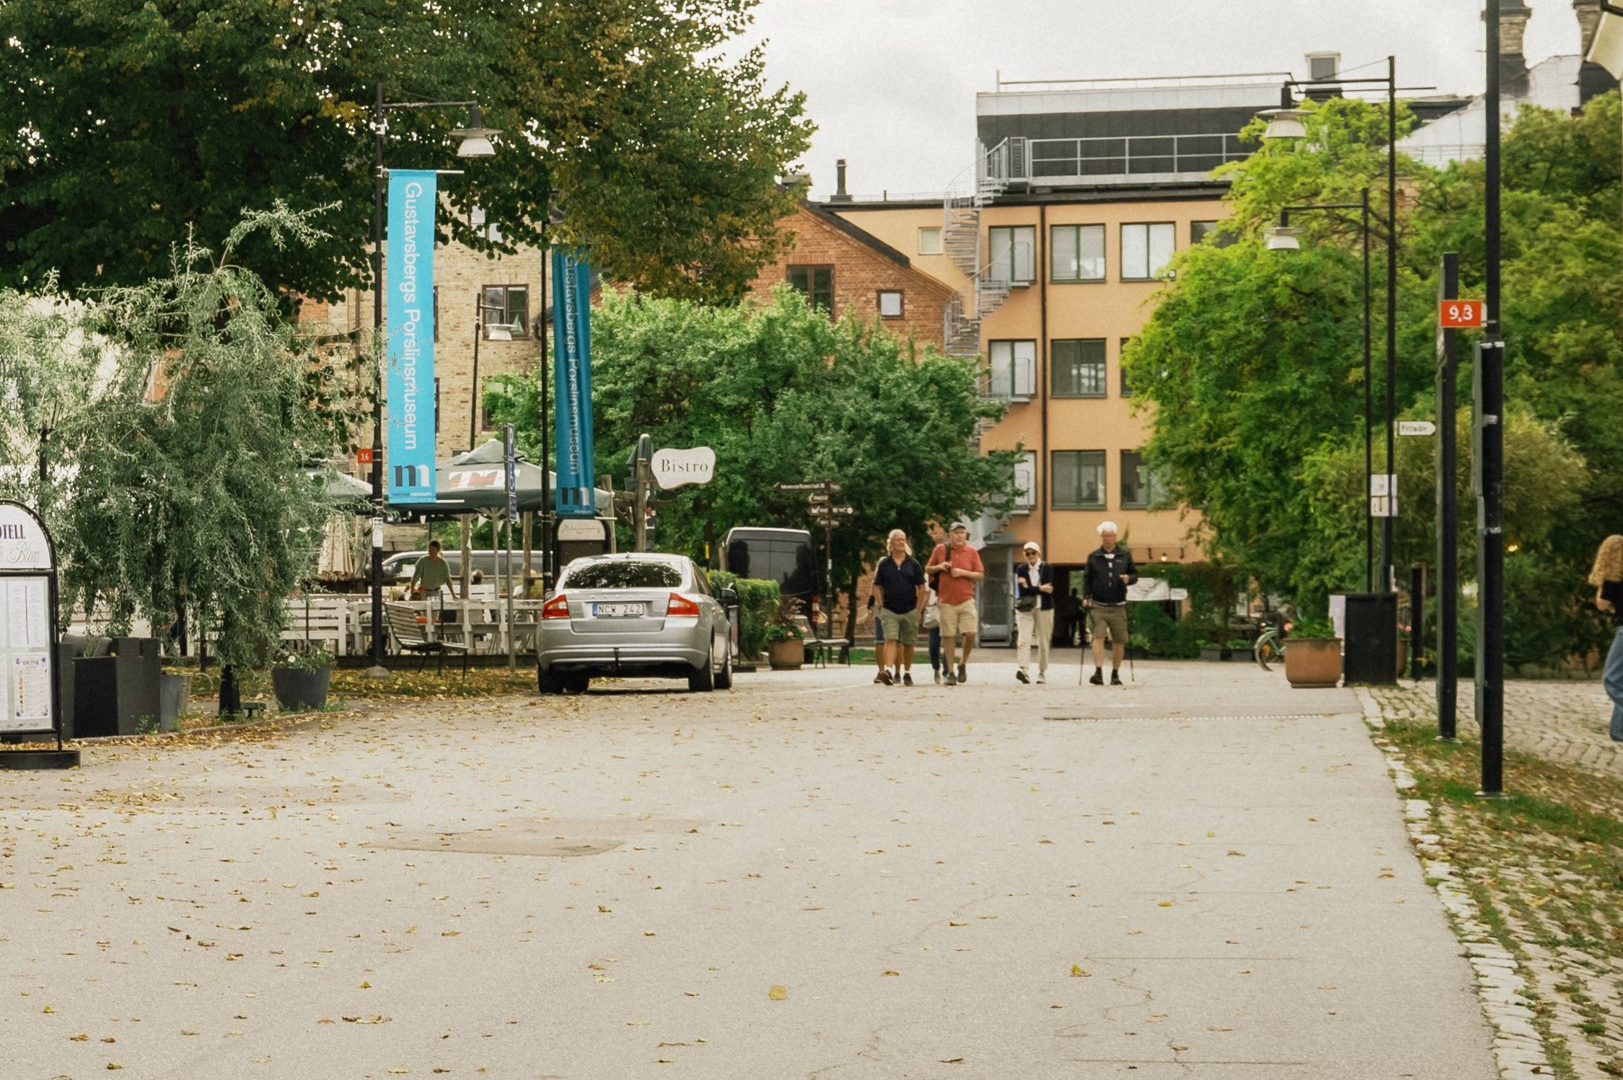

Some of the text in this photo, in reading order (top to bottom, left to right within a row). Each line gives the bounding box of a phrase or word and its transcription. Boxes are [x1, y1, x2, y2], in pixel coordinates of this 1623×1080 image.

[399, 181, 423, 451] Gustavsbergs Porslinsmuseum
[564, 254, 580, 476] Gustavsbergs Porslinsmuseum
[661, 459, 709, 473] Bistro
[598, 605, 641, 614] NCW 242
